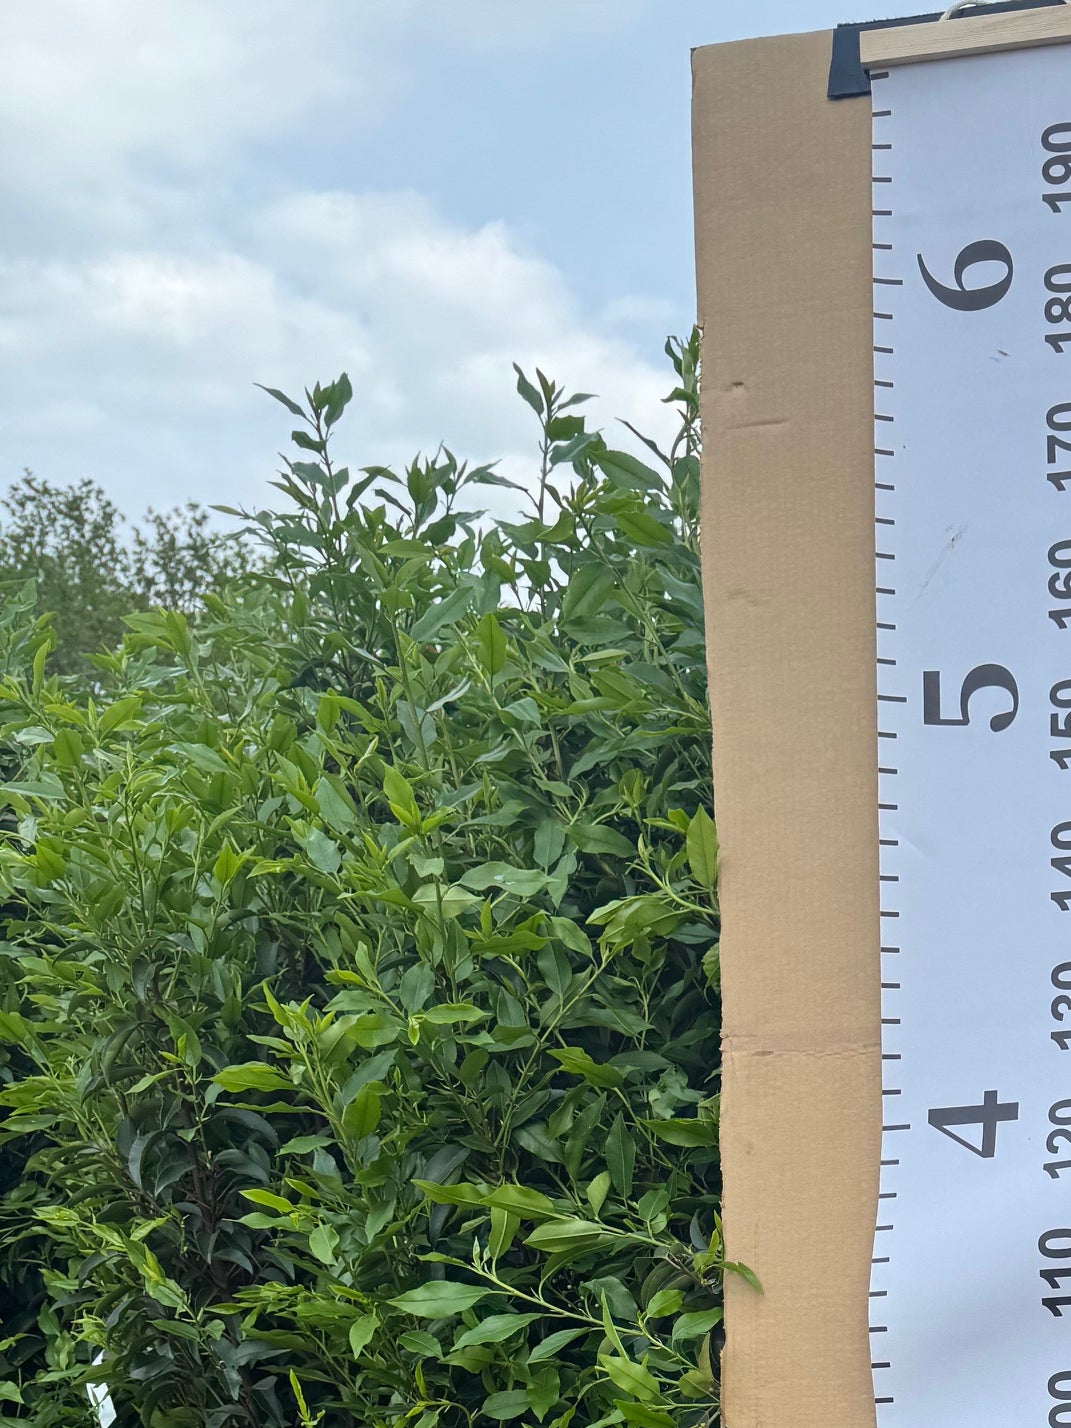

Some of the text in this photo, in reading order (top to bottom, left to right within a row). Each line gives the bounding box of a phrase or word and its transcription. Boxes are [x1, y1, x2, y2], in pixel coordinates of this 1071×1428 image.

[917, 240, 1013, 311] 6
[924, 664, 1018, 732] 5
[928, 1091, 1018, 1158] 4
